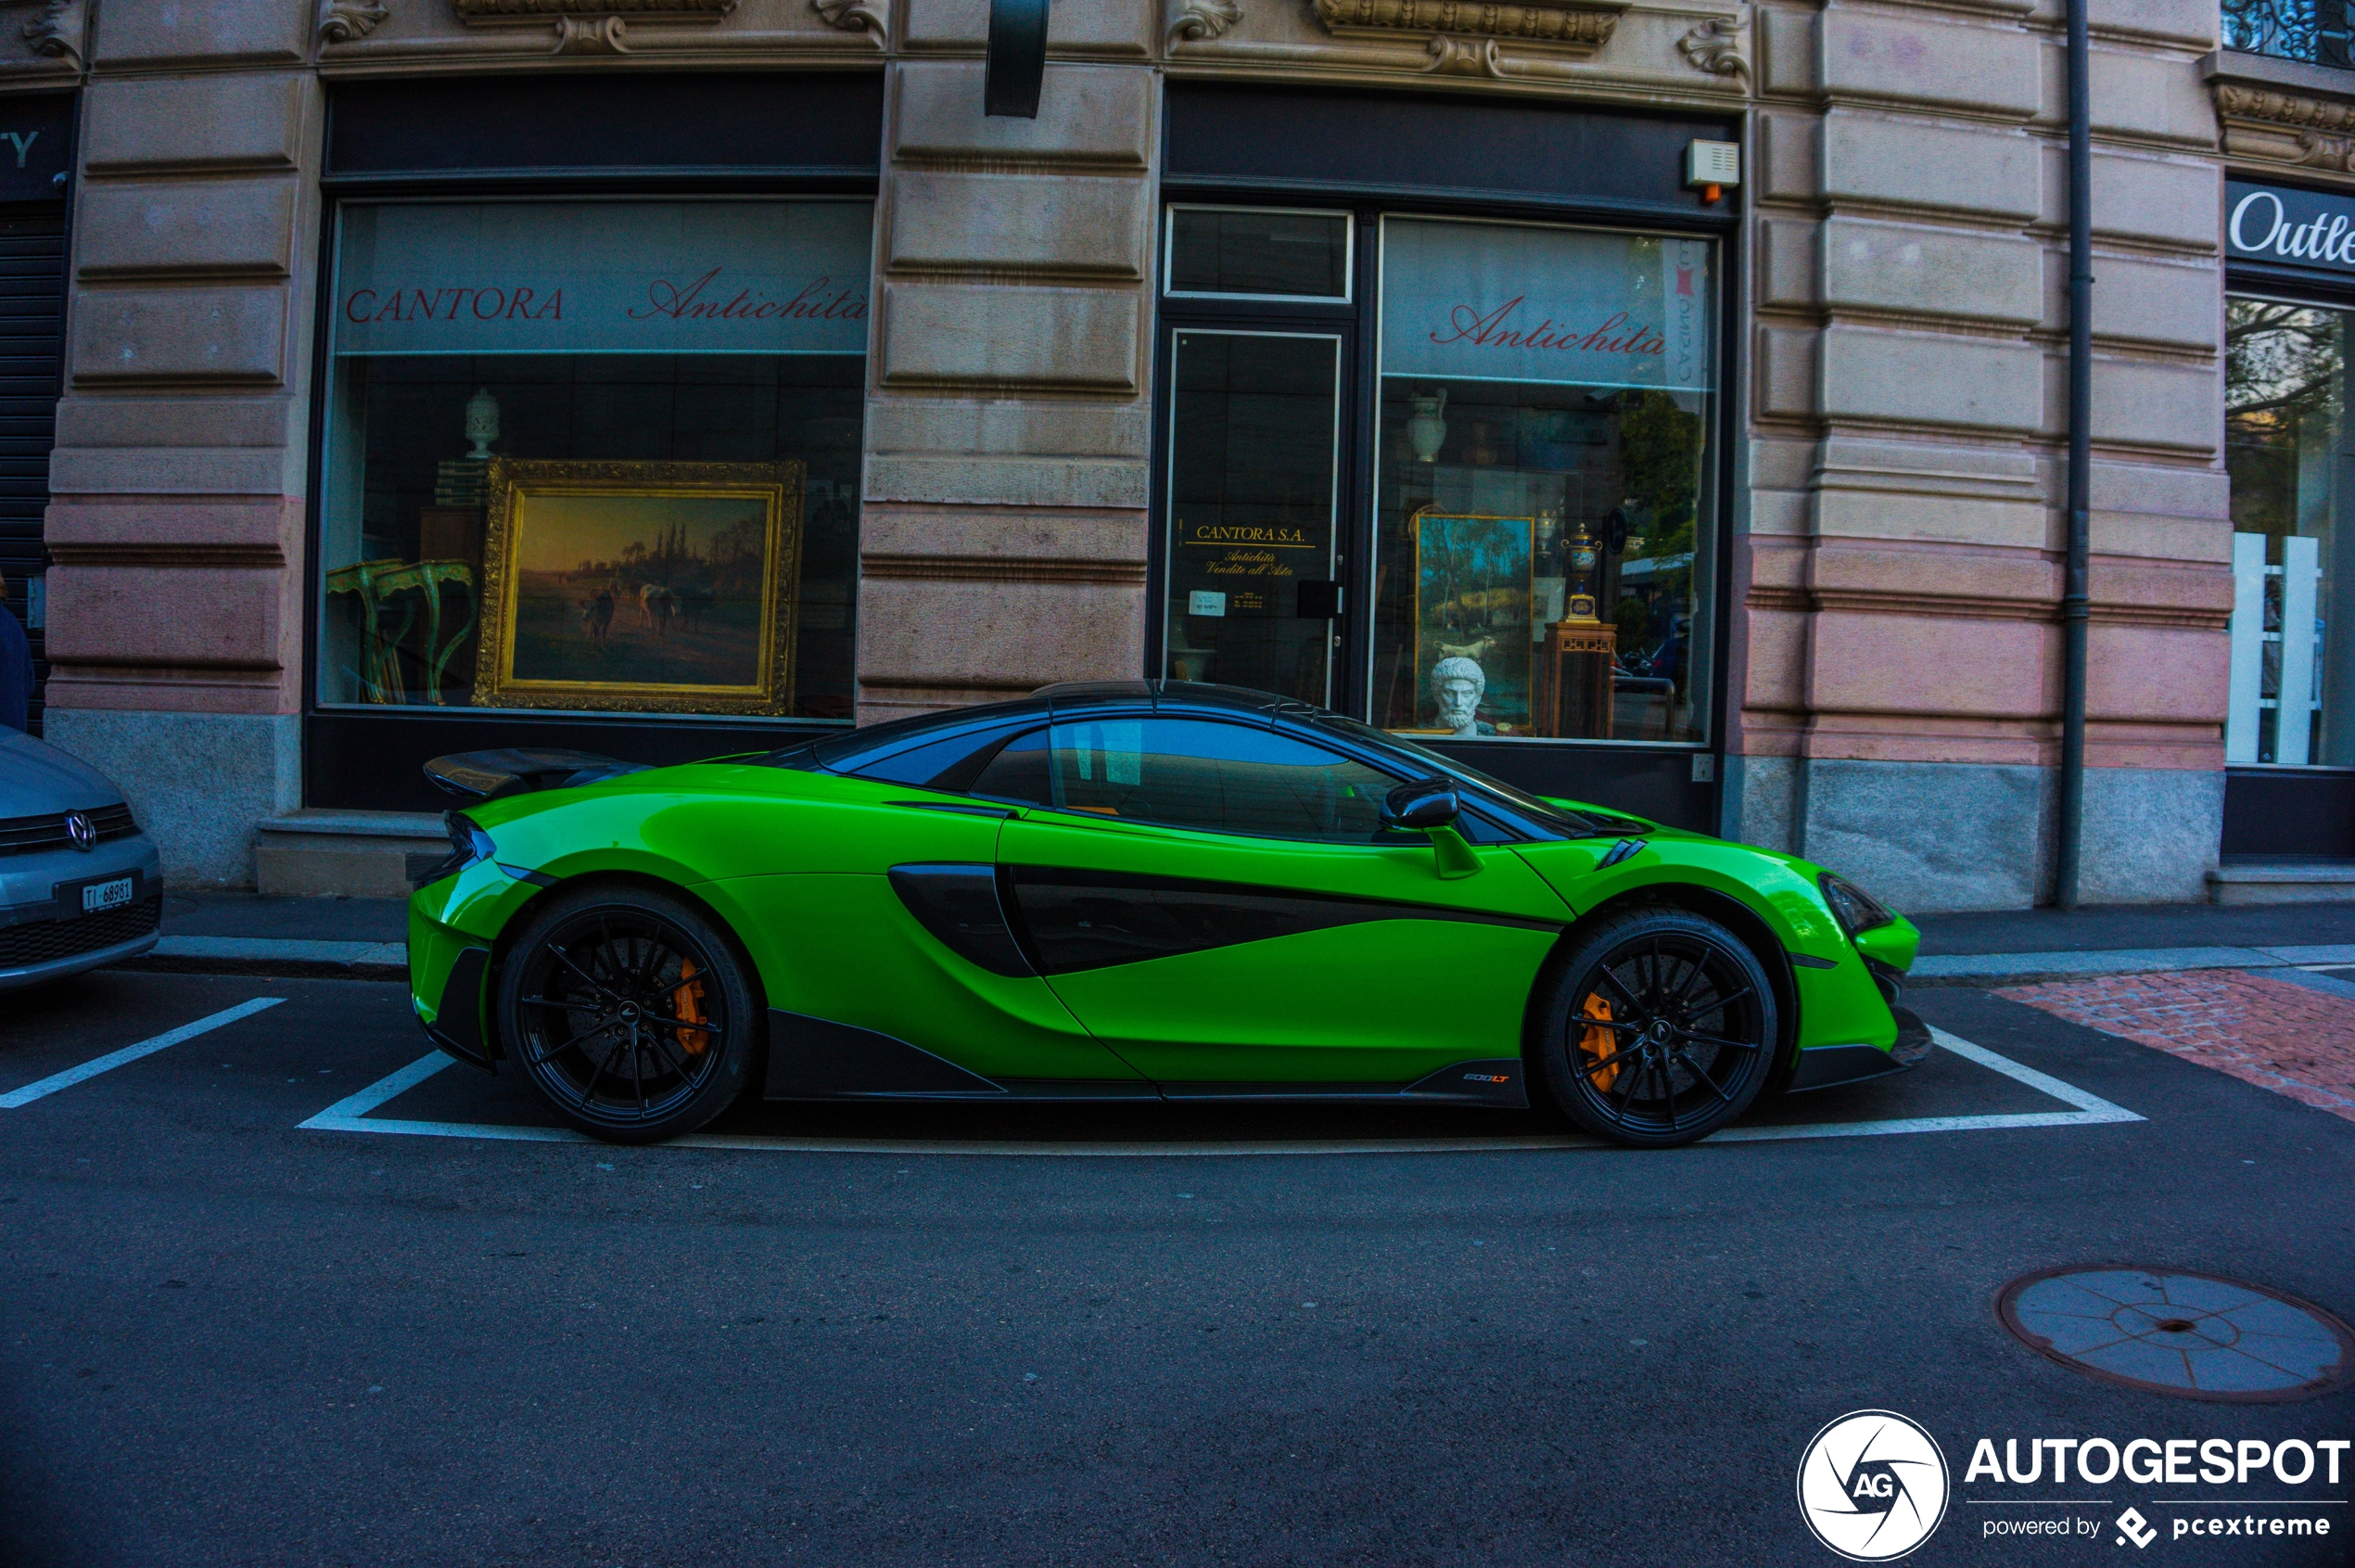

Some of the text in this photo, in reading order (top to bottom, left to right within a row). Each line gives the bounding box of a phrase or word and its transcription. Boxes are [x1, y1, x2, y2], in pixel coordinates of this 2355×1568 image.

[345, 265, 869, 324] CANTORA Antichità
[1429, 295, 1667, 355] Antichità
[1196, 525, 1305, 542] CANTORA S.A.
[1225, 549, 1275, 562] Antichità
[1206, 561, 1246, 573] Vendite
[1463, 1073, 1509, 1083] 600LT
